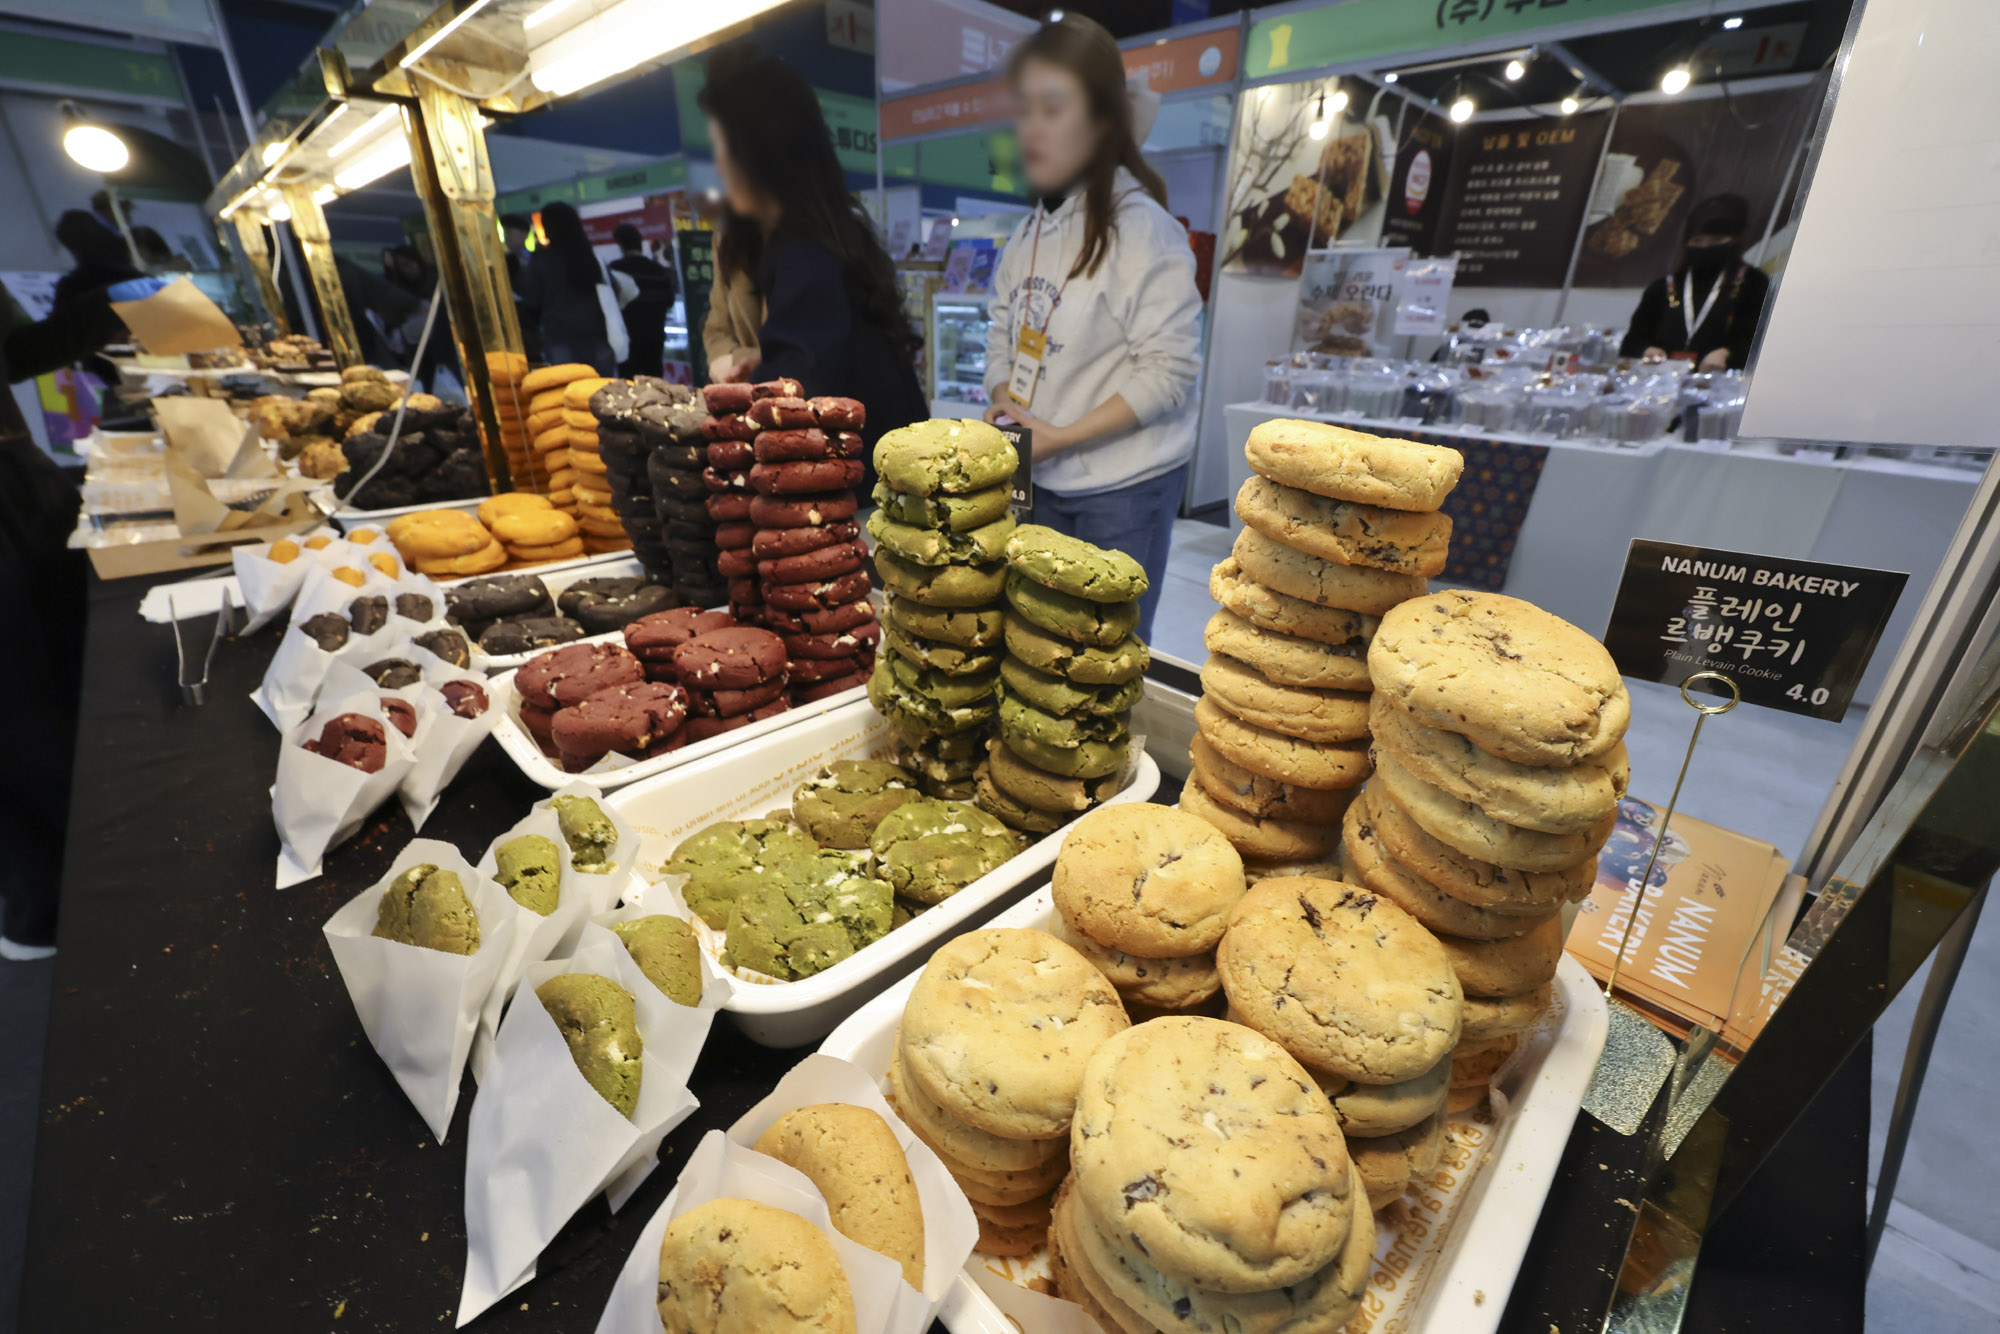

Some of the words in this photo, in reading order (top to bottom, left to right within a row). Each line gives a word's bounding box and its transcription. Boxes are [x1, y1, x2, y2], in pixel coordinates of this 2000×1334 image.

[1536, 129, 1575, 146] OEM
[1344, 283, 1393, 302] 오란다
[1003, 431, 1021, 443] ERY
[1012, 489, 1026, 501] 4.0
[1661, 556, 1747, 583] NANUM
[1752, 570, 1860, 598] BAKERY
[1688, 586, 1802, 632] 플레인
[1660, 617, 1806, 666] 르뱅쿠키
[1663, 649, 1693, 664] Plain
[1695, 656, 1736, 672] Levain
[1738, 664, 1783, 681] Cookie
[1785, 684, 1830, 706] 4.0
[1597, 878, 1665, 966] BAKERY
[1650, 897, 1717, 991] NANUM
